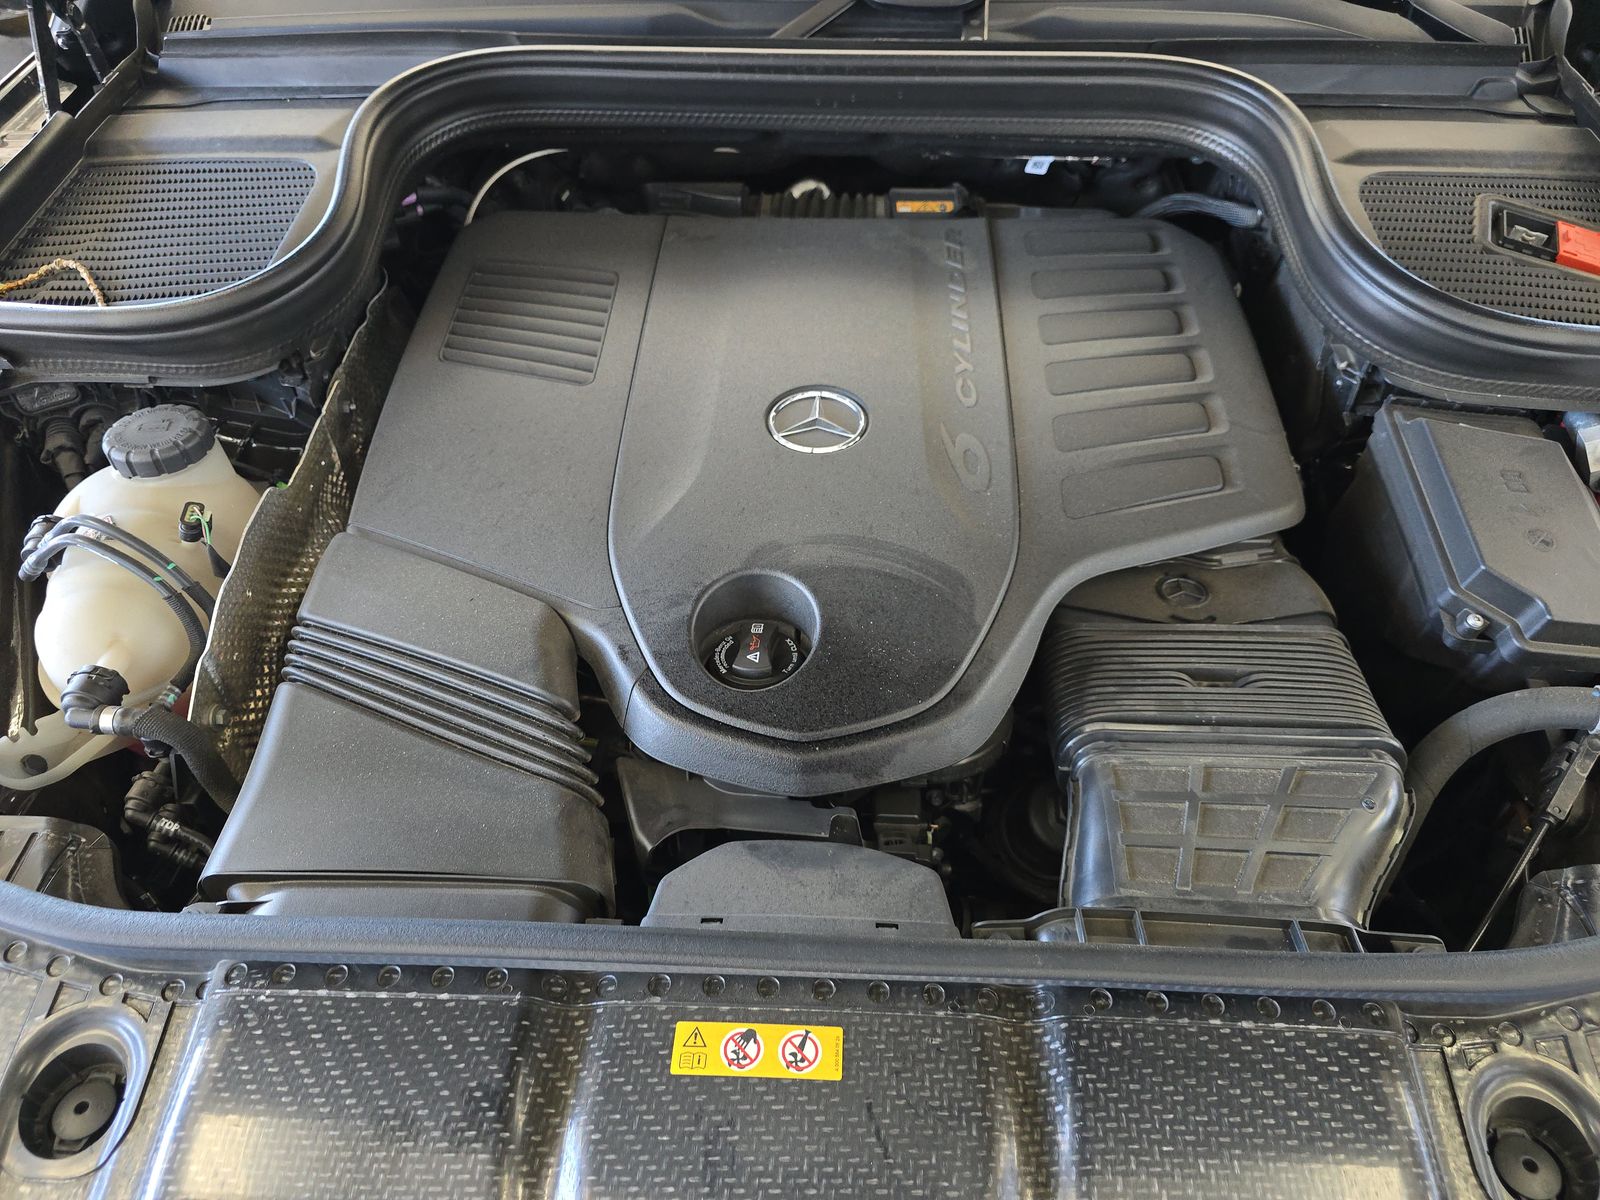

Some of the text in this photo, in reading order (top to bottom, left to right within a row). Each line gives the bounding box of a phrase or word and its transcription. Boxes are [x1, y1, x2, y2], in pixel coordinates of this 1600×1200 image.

[940, 227, 992, 496] 6 CYLINDER
[160, 817, 180, 831] TOP
